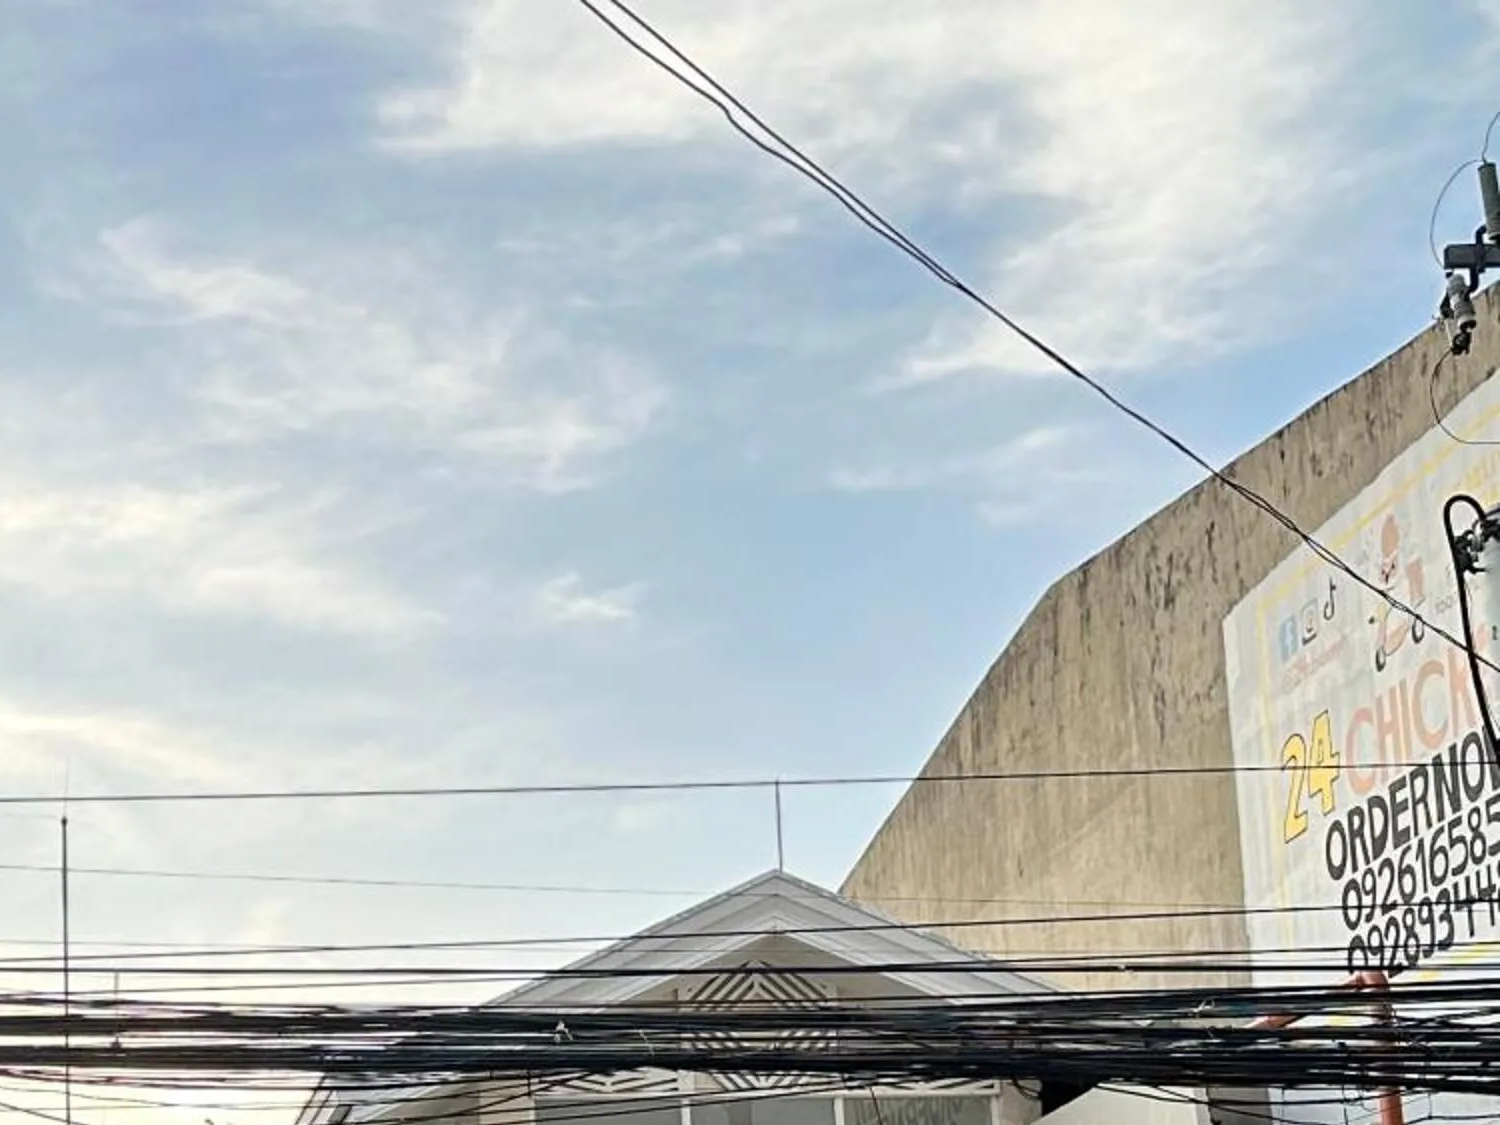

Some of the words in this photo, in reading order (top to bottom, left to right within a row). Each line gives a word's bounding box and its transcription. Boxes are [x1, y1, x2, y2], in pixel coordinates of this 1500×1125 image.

[1281, 708, 1341, 844] 24
[1346, 624, 1489, 796] CHICK
[1348, 862, 1500, 979] 09289344
